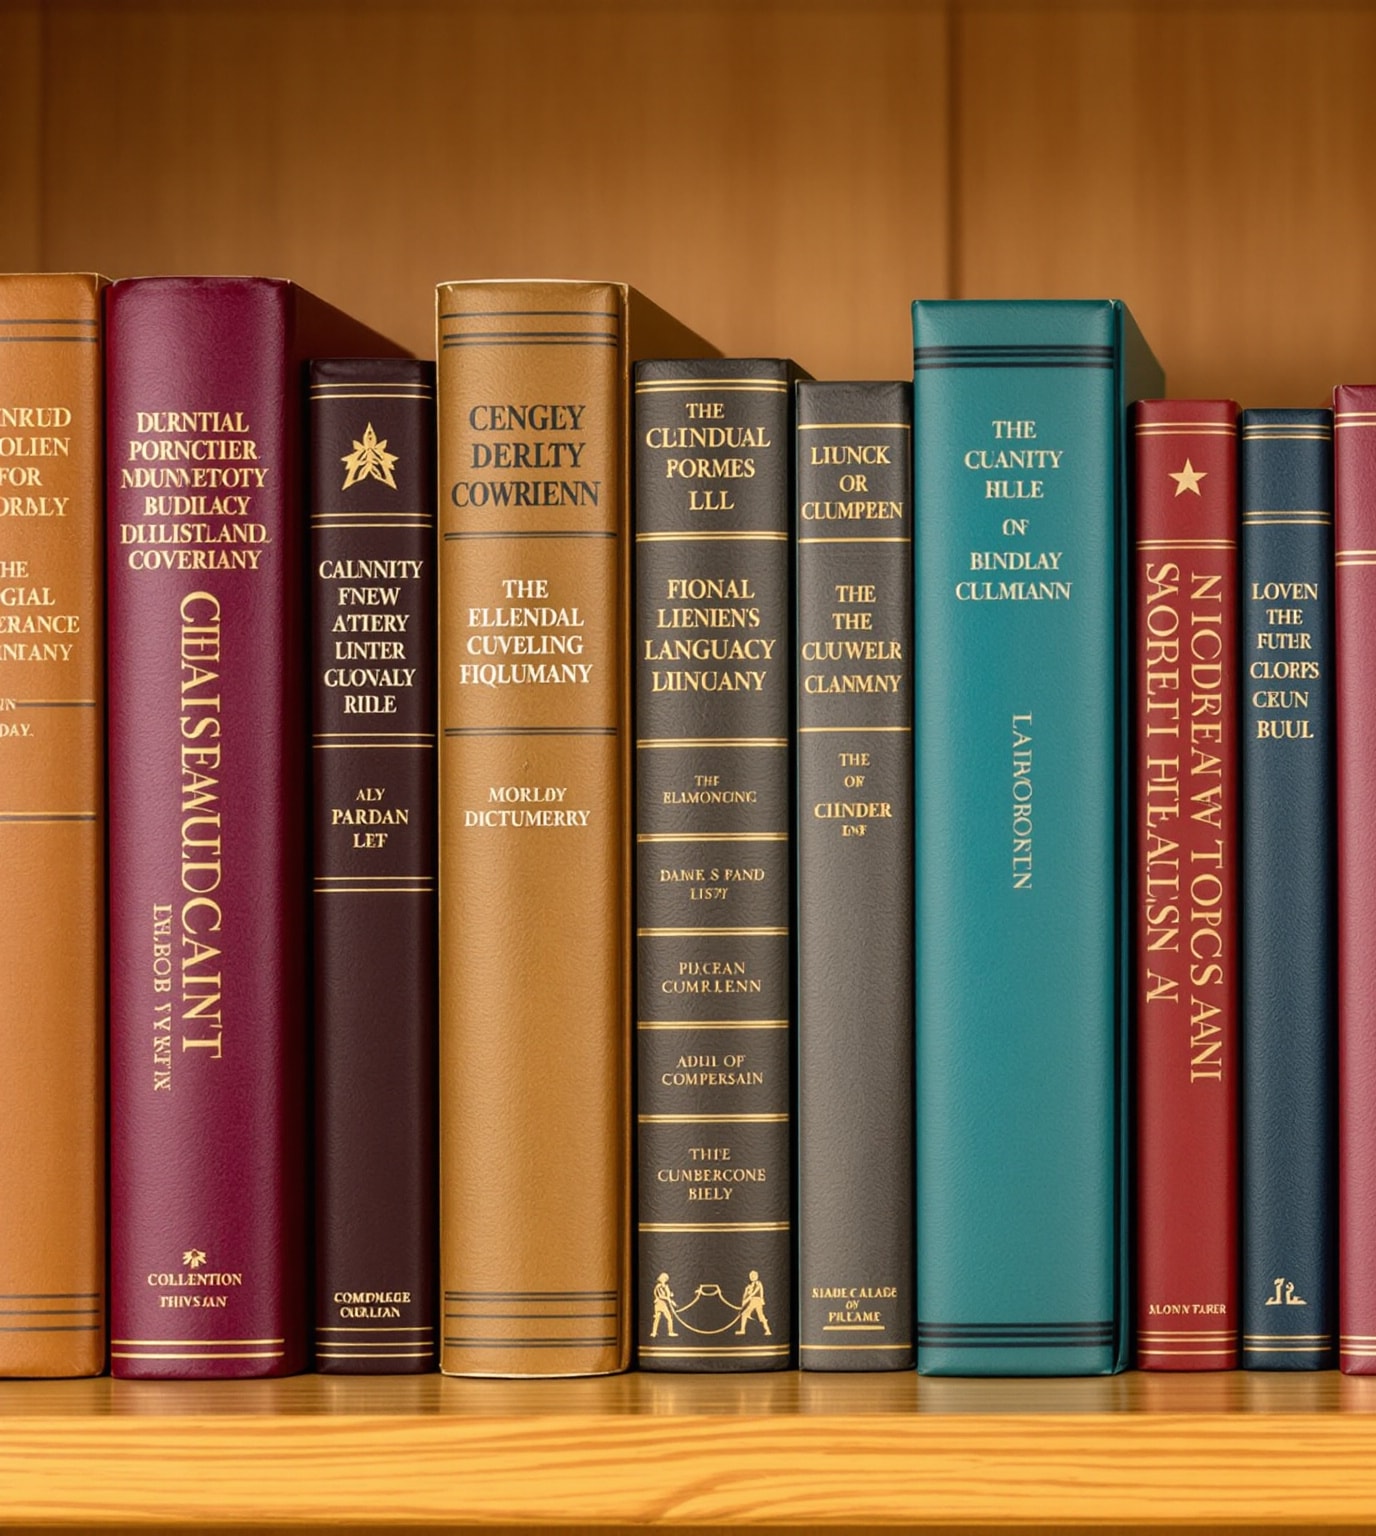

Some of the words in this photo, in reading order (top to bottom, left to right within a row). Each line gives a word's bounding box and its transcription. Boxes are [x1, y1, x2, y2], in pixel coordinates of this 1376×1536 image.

[686, 403, 725, 419] THE
[992, 421, 1037, 439] THE
[0, 467, 43, 487] FOR
[839, 475, 869, 492] OR
[689, 490, 735, 510] LLL
[503, 580, 549, 598] THE
[667, 579, 756, 599] FIONAL
[835, 585, 877, 603] THE
[1252, 582, 1319, 600] LOVEN
[832, 613, 872, 630] THE
[1266, 609, 1303, 624] THE
[467, 635, 584, 655] CUVELING
[838, 753, 871, 767] THE
[331, 809, 409, 825] PARDAN
